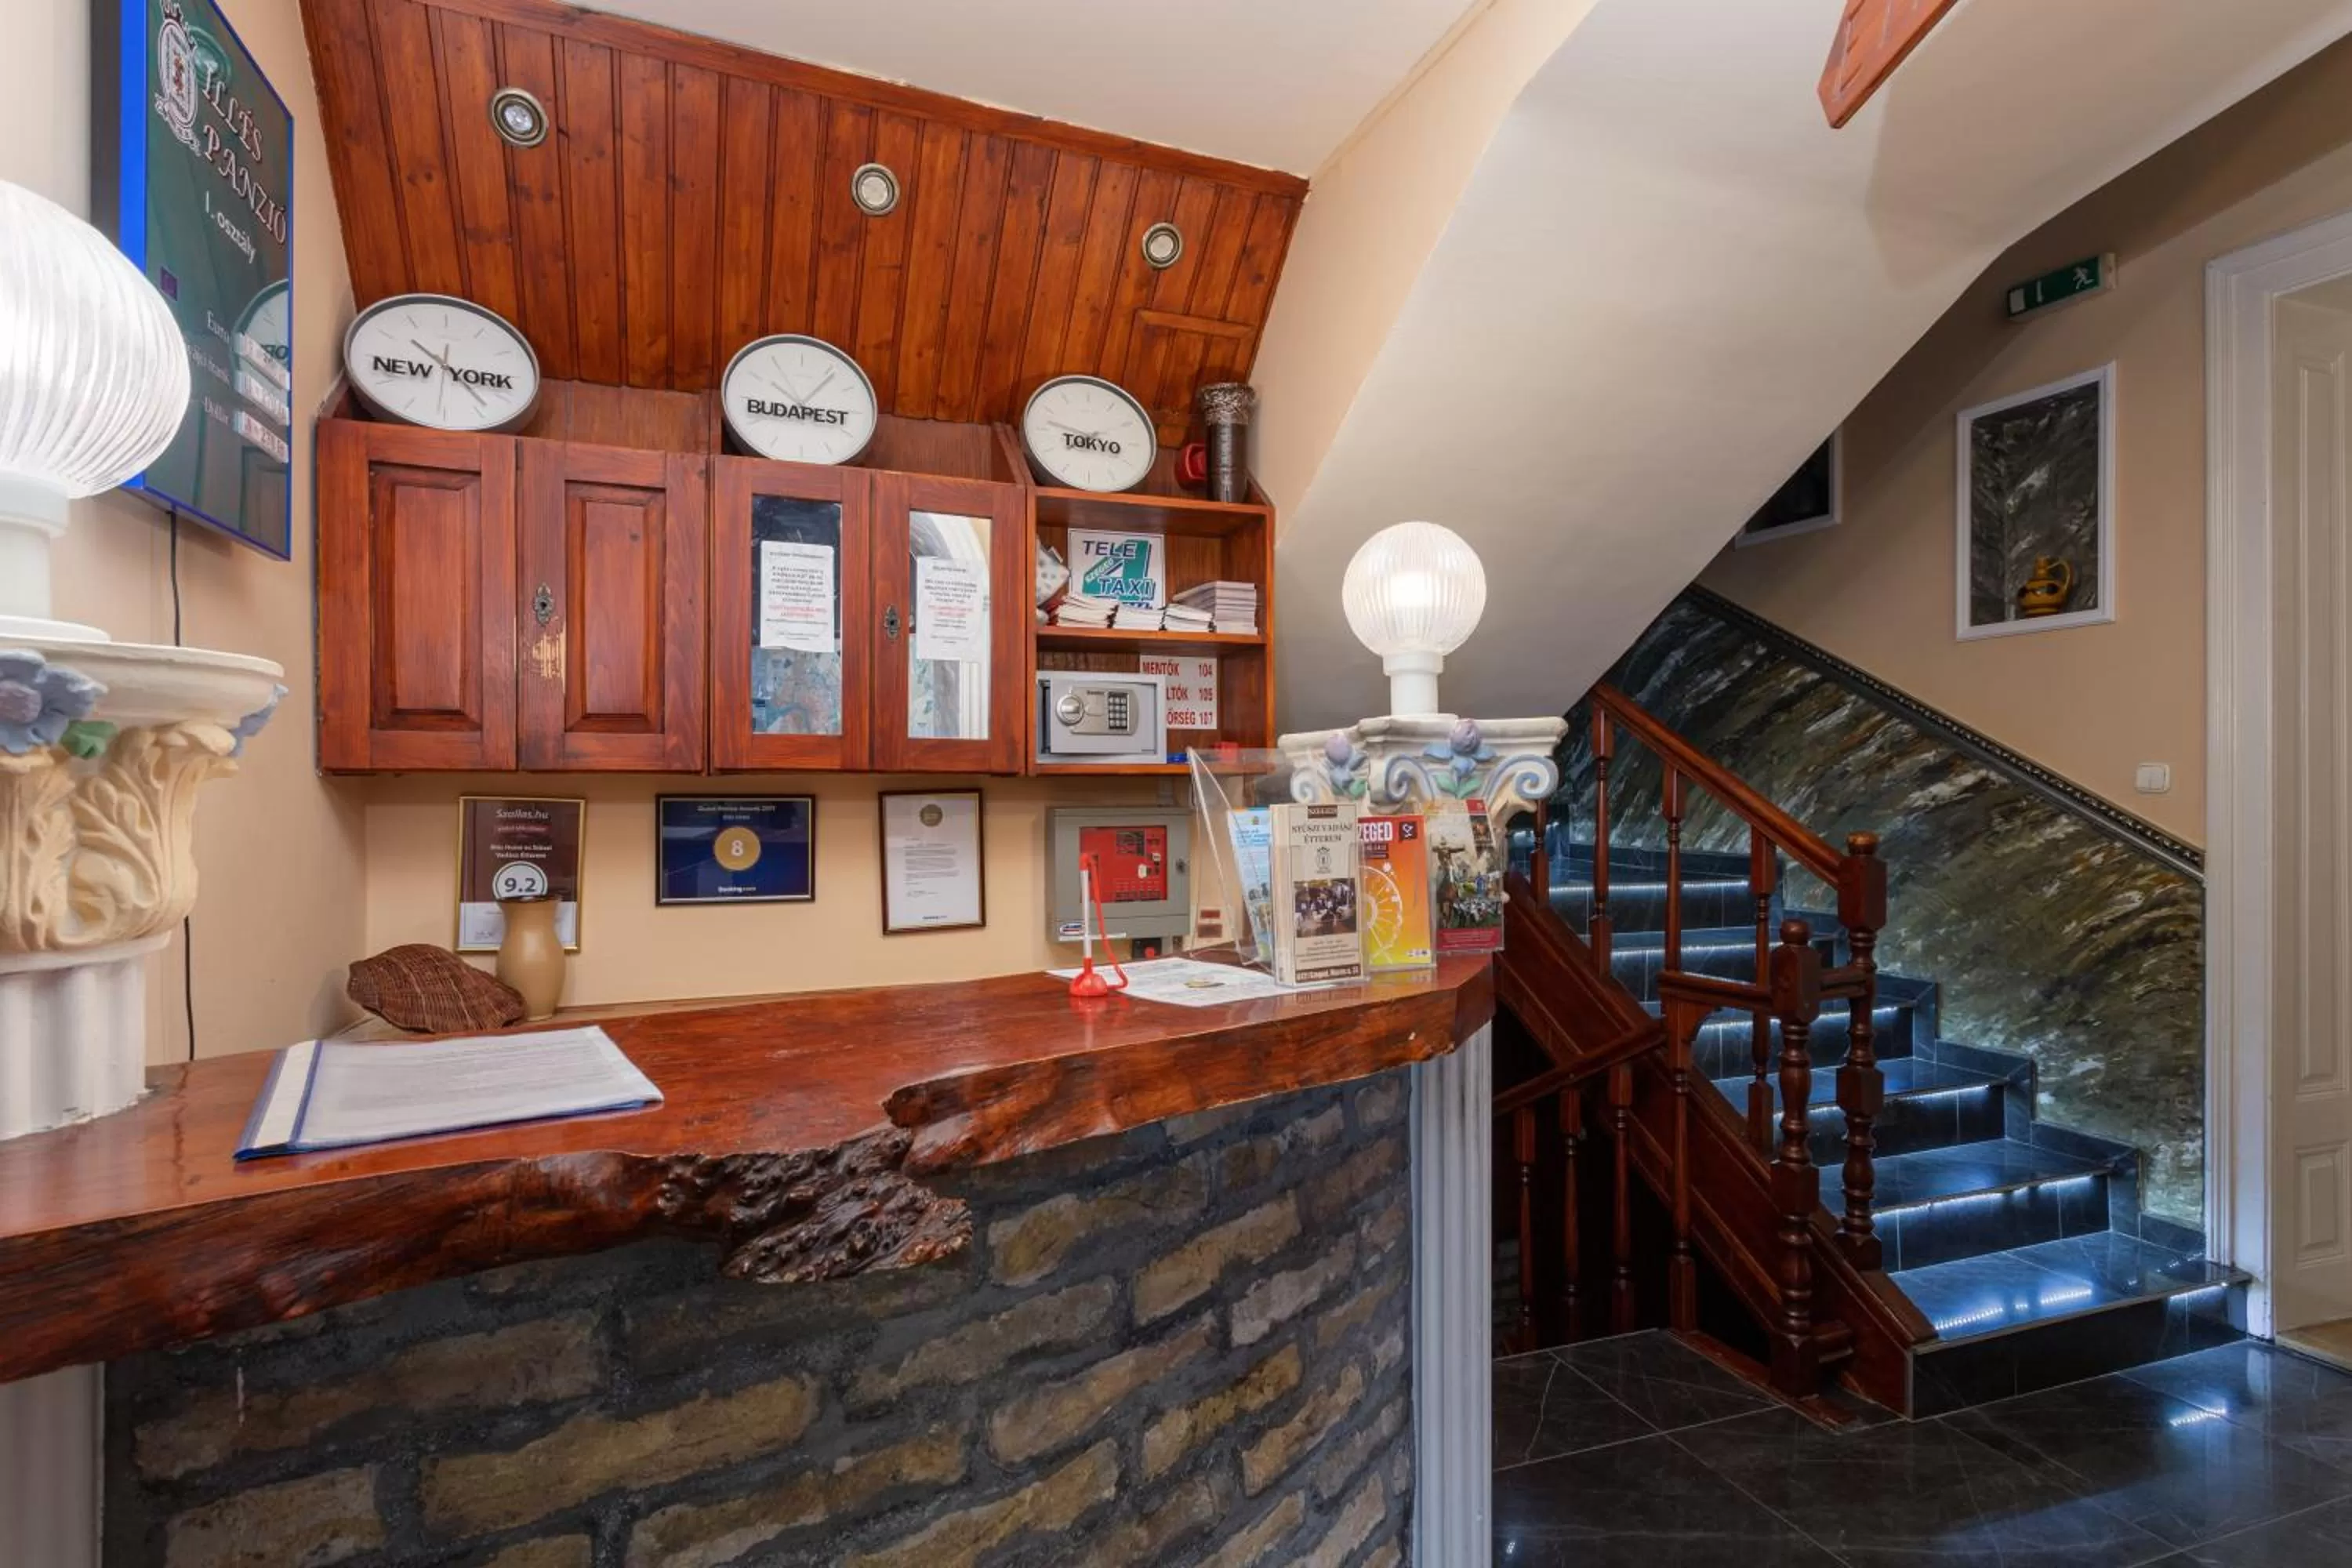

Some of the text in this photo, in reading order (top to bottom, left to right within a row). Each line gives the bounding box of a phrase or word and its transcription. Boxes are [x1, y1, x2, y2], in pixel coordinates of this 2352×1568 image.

[202, 60, 263, 162] ILLÉS
[203, 124, 287, 245] PANZIÓ
[372, 356, 513, 390] NEW YORK
[746, 398, 849, 426] BUDAPEST
[1062, 432, 1121, 455] TOKYO
[1083, 540, 1138, 558] TELE
[1098, 577, 1155, 597] TAXI
[1142, 659, 1214, 678] MENTŐK 104
[1199, 688, 1214, 702] 105
[1167, 707, 1196, 725] ŐRSÉG
[1358, 822, 1393, 842] ZEGED
[731, 840, 744, 857] 8
[504, 877, 536, 893] 9.2
